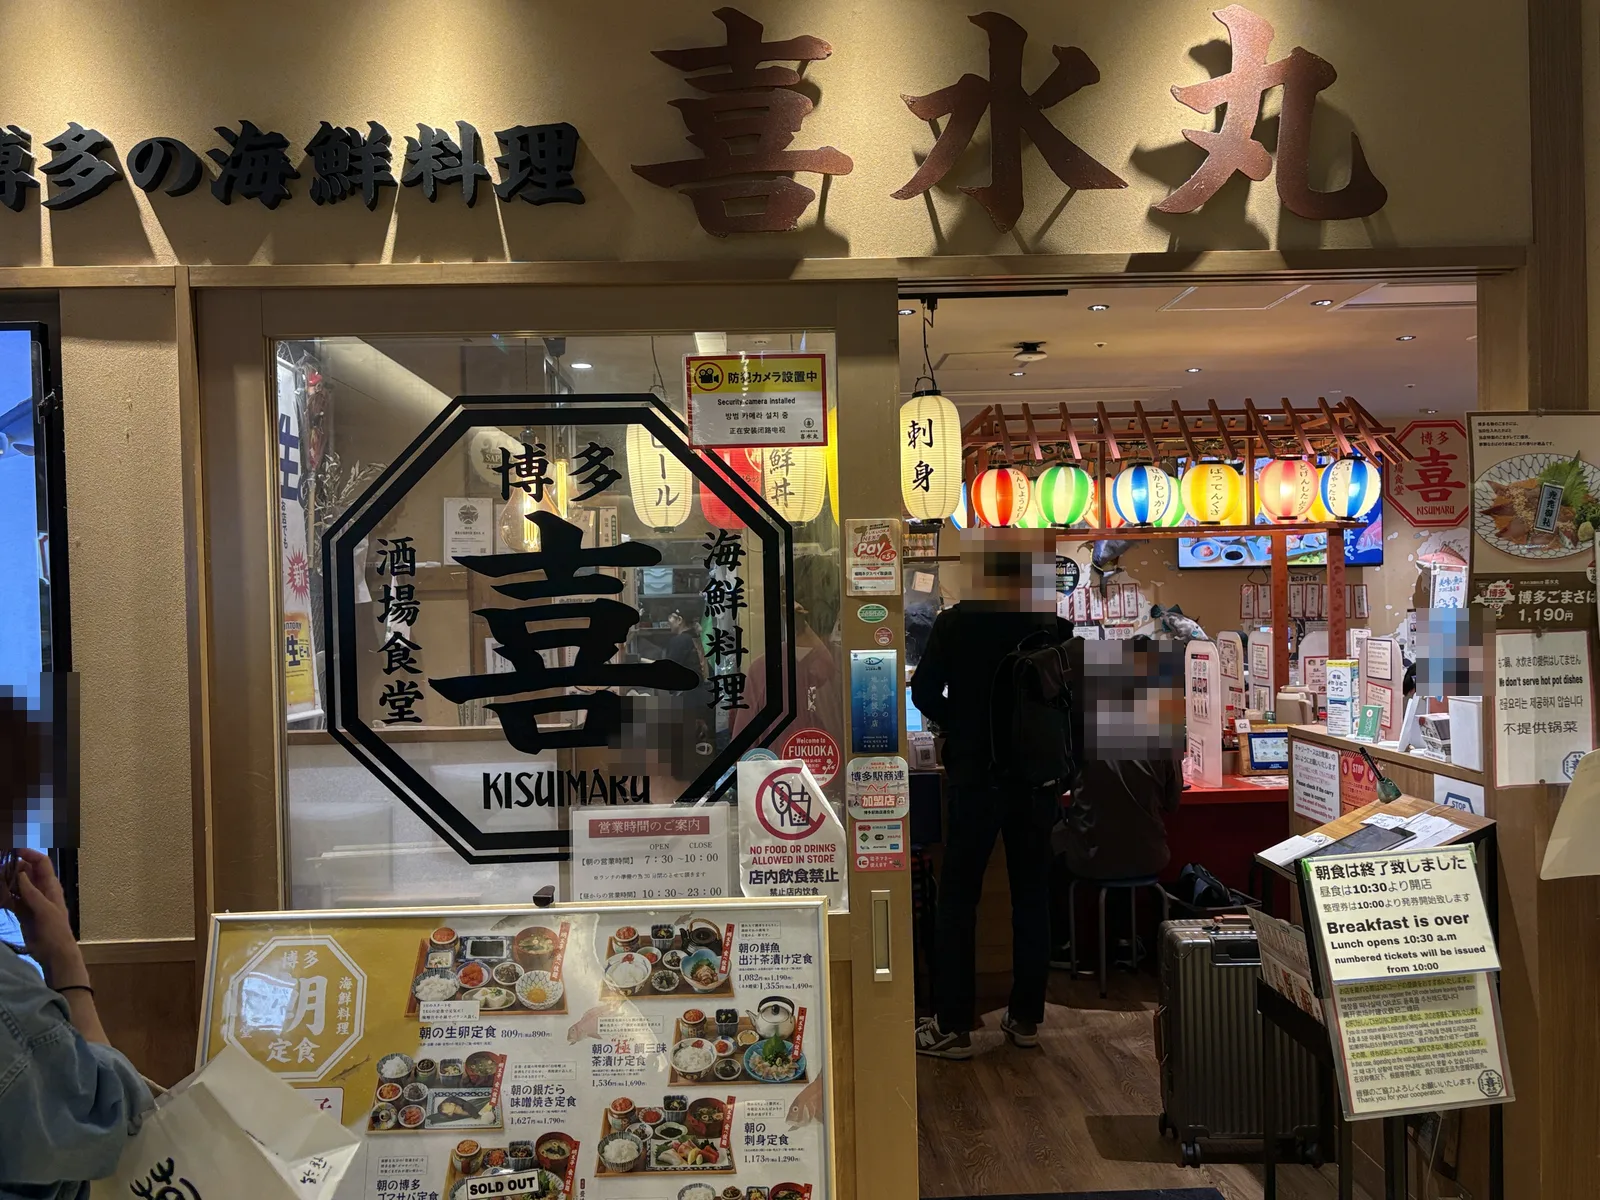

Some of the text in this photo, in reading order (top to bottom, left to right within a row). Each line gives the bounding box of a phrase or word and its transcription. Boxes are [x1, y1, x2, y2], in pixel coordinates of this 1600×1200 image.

[631, 5, 1388, 237] 喜水丸
[727, 370, 818, 384] 防犯カメラ設置中
[717, 398, 743, 406] Security
[769, 397, 796, 405] installed
[742, 412, 763, 420] 카메라
[782, 411, 788, 419] 중
[1420, 431, 1449, 446] 博多
[907, 418, 934, 493] 刺身
[491, 441, 623, 503] 博多
[1404, 447, 1466, 503] 喜
[1416, 505, 1455, 515] KISUIMARU
[702, 528, 750, 711] 海鮮料理
[1518, 607, 1574, 623] 1,190円
[376, 535, 425, 724] 酒場食堂
[427, 510, 701, 755] 喜
[1505, 677, 1522, 687] don't
[1522, 678, 1540, 686] serve
[1540, 675, 1552, 685] hot
[1551, 675, 1564, 687] pot
[1563, 674, 1584, 685] dishes
[1529, 696, 1556, 709] 제공하지
[1557, 694, 1584, 708] 않습니다
[1503, 720, 1578, 736] 不提供锅菜
[796, 737, 818, 745] Welcome
[788, 745, 835, 758] FUKUOKA
[850, 770, 905, 782] 博多駅商連
[1352, 763, 1364, 775] STOP
[482, 768, 654, 810] KISUIMARU
[866, 782, 890, 793] ペイ
[861, 795, 896, 807] 加盟店
[597, 818, 701, 835] 営業時間のご案内
[688, 841, 713, 849] CLOSE
[750, 843, 837, 855] NO FOOD OR DRINKS
[751, 854, 835, 865] ALLOWED IN STORE
[1315, 855, 1468, 881] 朝食は終了致しました
[748, 868, 840, 886] 店内飲食禁止
[1319, 878, 1433, 898] 昼食は10:30より開店
[1322, 892, 1471, 913] 整理券は10:00より発券開始致します
[1326, 912, 1471, 935] Breakfast is over
[738, 942, 781, 954] 朝の鮮魚
[1330, 932, 1458, 950] Lunch opens 10:30 a.m
[281, 949, 320, 969] 博多
[738, 953, 813, 966] 出汁茶漬け定食
[1334, 945, 1487, 965] numbered tickets will be issued
[1386, 962, 1439, 974] from 10:00
[335, 976, 353, 1036] 海鮮料理
[419, 1026, 497, 1040] 朝の生卵定食
[266, 1036, 321, 1064] 定食
[591, 1055, 647, 1067] 茶漬け定食
[510, 1084, 566, 1096] 朝の銀だら
[510, 1095, 577, 1108] 味噌焼き定食
[1357, 1096, 1375, 1104] Thank
[743, 1122, 766, 1134] 朝の
[743, 1133, 789, 1146] 刺身定食
[376, 1178, 421, 1192] 朝の博多
[469, 1177, 536, 1196] SOLD OUT
